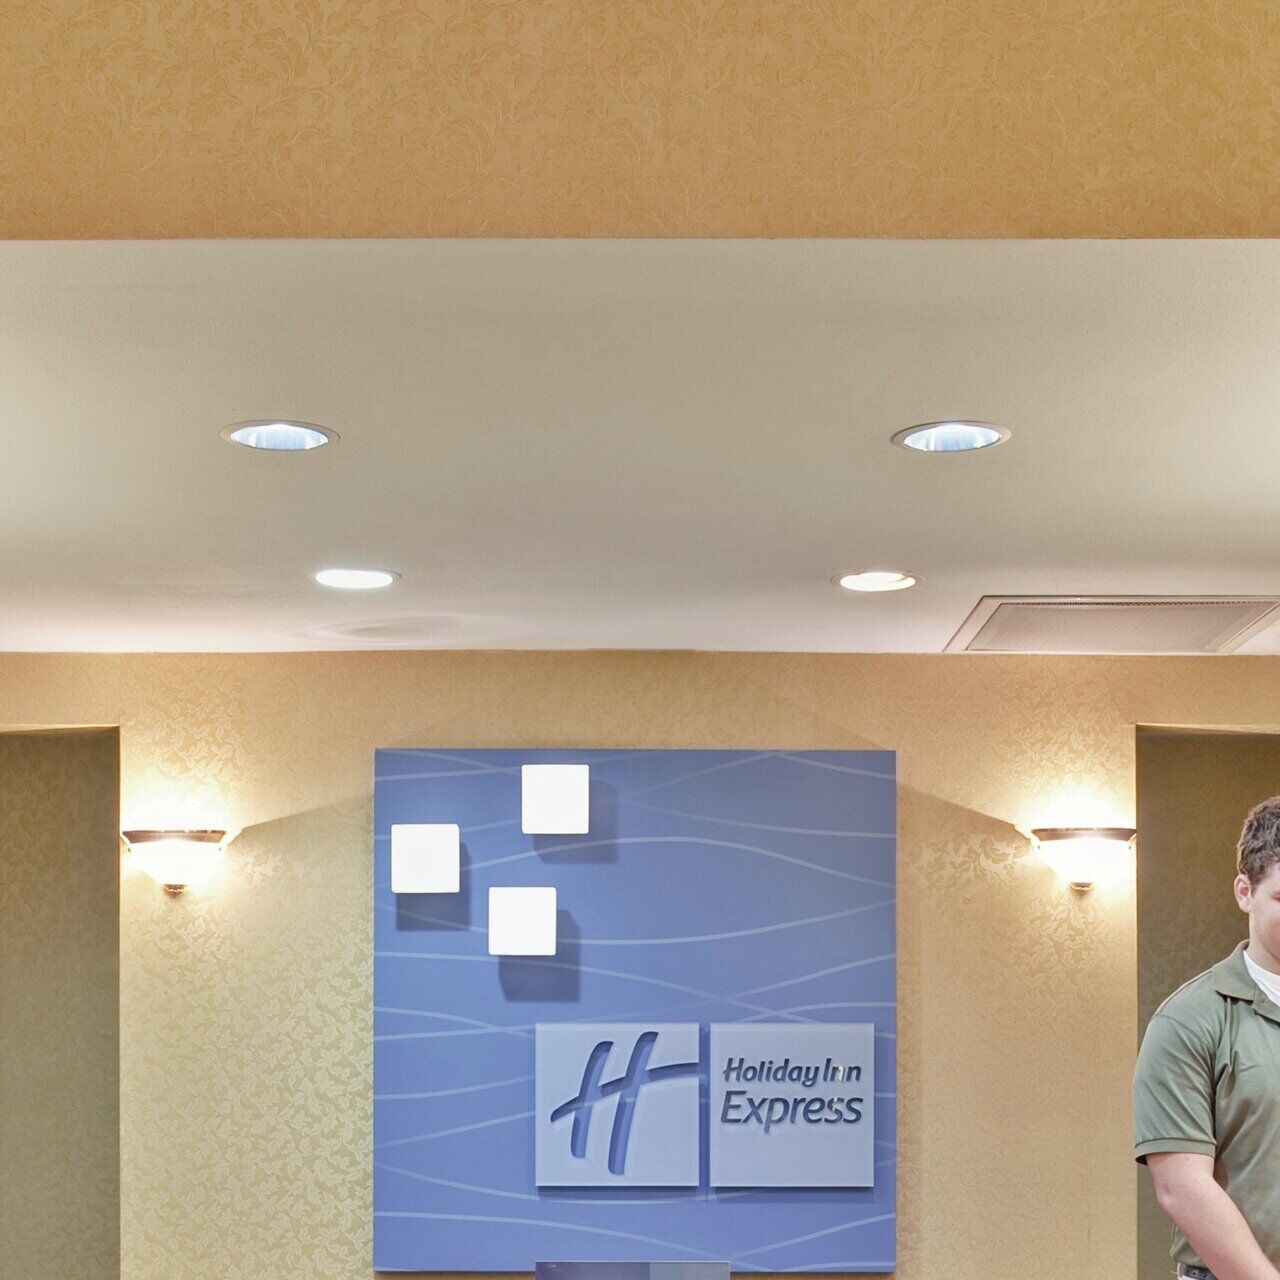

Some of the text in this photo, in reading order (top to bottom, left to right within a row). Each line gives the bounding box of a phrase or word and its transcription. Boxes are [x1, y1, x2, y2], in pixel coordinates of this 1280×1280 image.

[722, 1058, 862, 1087] Holiday Inn
[720, 1090, 864, 1134] Express
